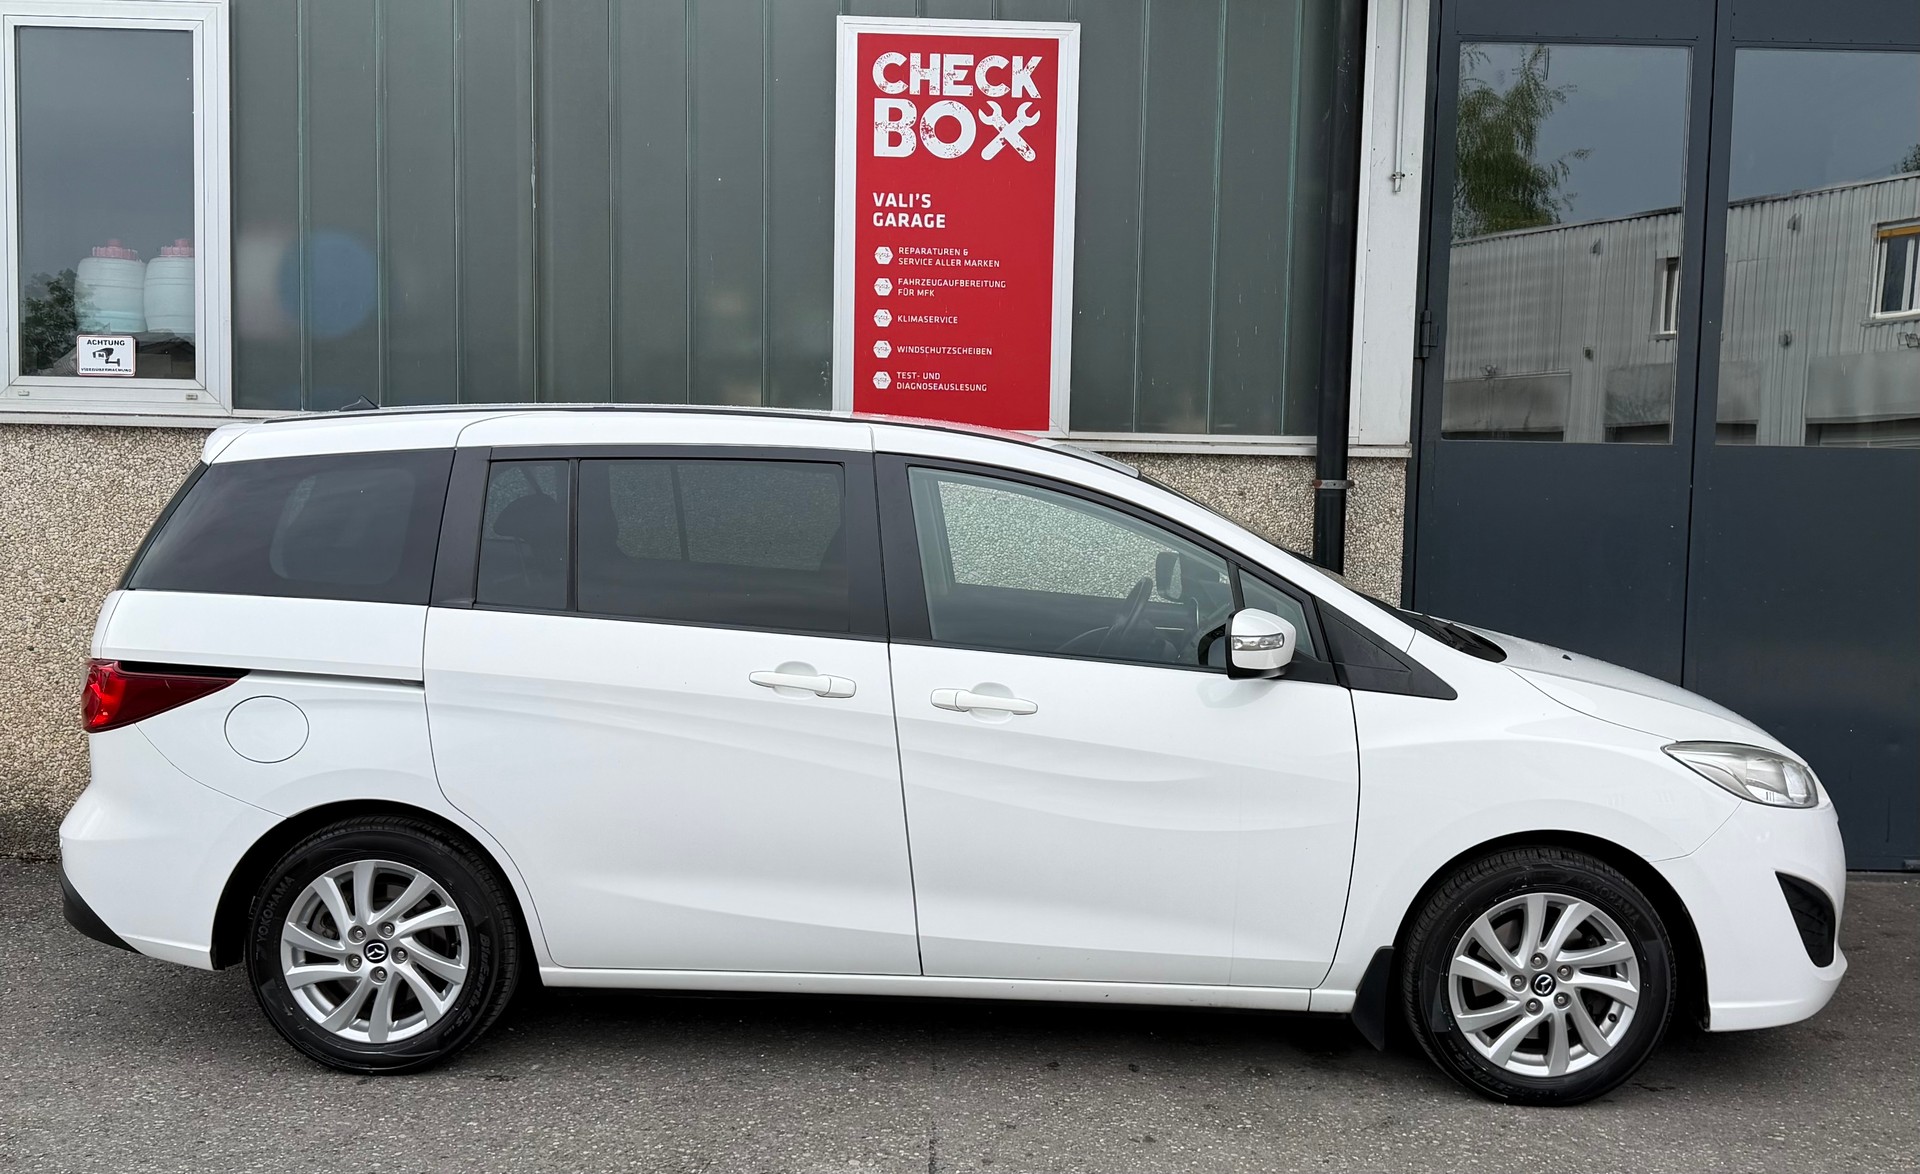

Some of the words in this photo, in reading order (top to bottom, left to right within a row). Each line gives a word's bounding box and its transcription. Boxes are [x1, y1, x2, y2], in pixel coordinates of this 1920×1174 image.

[872, 51, 1043, 99] CHECK
[873, 97, 1041, 162] BOX
[872, 192, 932, 209] VALI'S
[872, 211, 946, 228] GARAGE
[898, 247, 961, 256] REPARATUREN
[898, 257, 933, 266] SERVICE
[935, 259, 962, 267] ALLER
[964, 259, 1000, 268] MARKEN
[898, 278, 1006, 288] FAHRZEUGAUFBEREITUNG
[897, 287, 915, 297] FÜR
[916, 289, 935, 297] MFK
[897, 315, 958, 324] KLIMASERVICE
[896, 346, 993, 356] WINDSCHUTZSCHEIBEN
[896, 371, 920, 380] TEST-
[922, 372, 941, 380] UND
[896, 382, 987, 392] DIAGNOSEAUSLESUNG
[256, 875, 296, 943] YOKOHAMA
